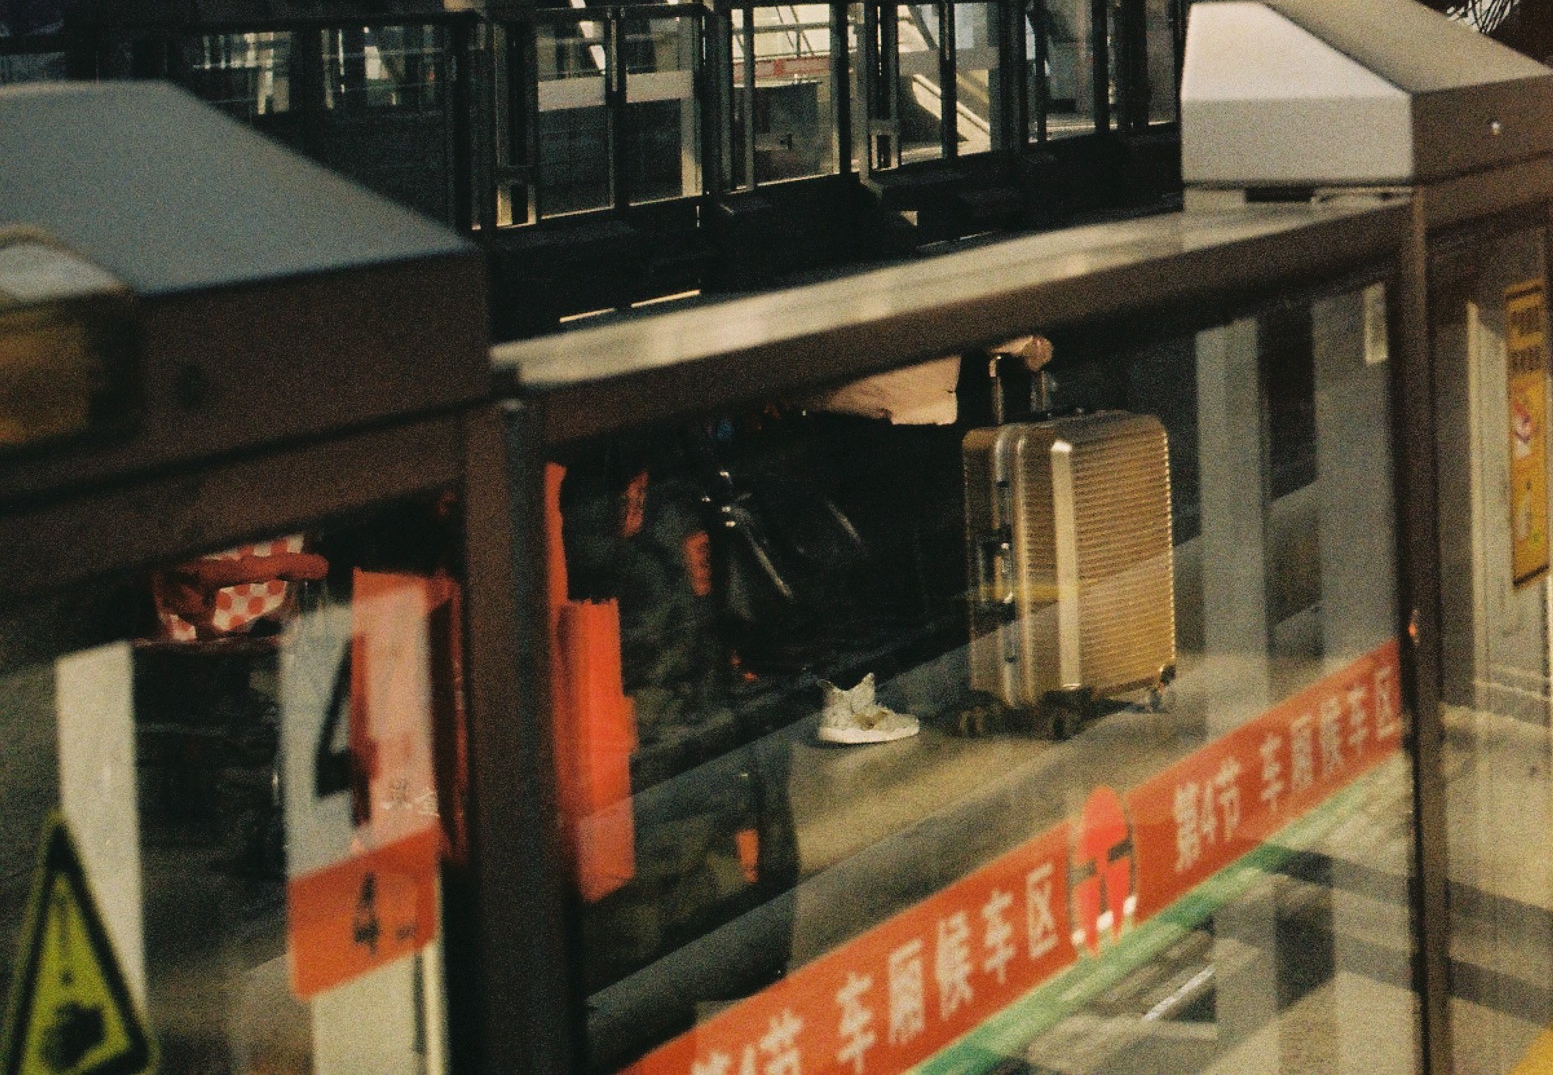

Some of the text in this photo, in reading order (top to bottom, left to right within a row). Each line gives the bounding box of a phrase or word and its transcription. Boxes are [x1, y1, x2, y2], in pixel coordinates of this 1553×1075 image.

[1173, 665, 1401, 874] 第4节 车厢候车区
[836, 862, 1060, 1075] 车厢候车区
